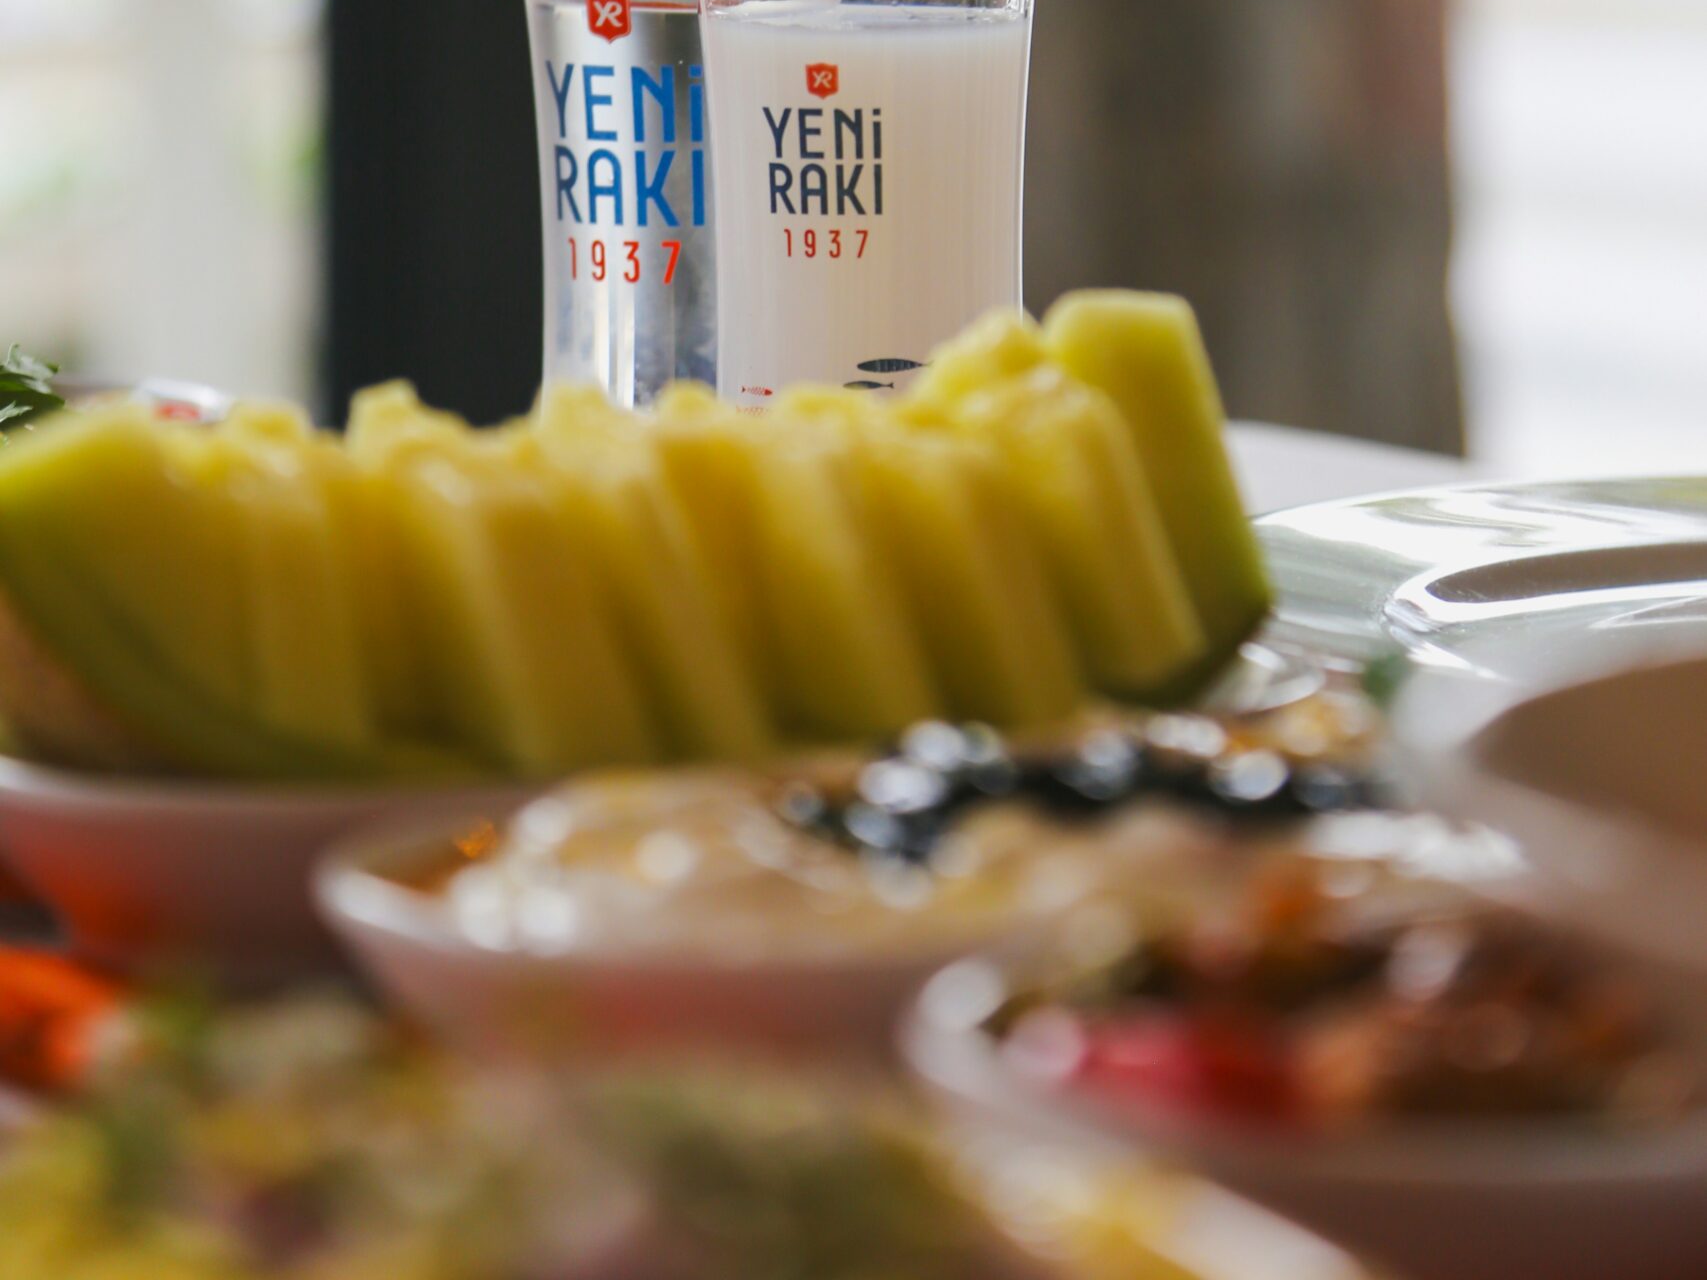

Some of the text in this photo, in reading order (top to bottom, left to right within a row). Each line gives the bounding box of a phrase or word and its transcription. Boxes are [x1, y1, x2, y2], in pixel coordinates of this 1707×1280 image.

[554, 144, 705, 227] RAKI
[769, 162, 883, 215] RAKI
[568, 237, 682, 285] 1937
[784, 228, 869, 258] 1937
